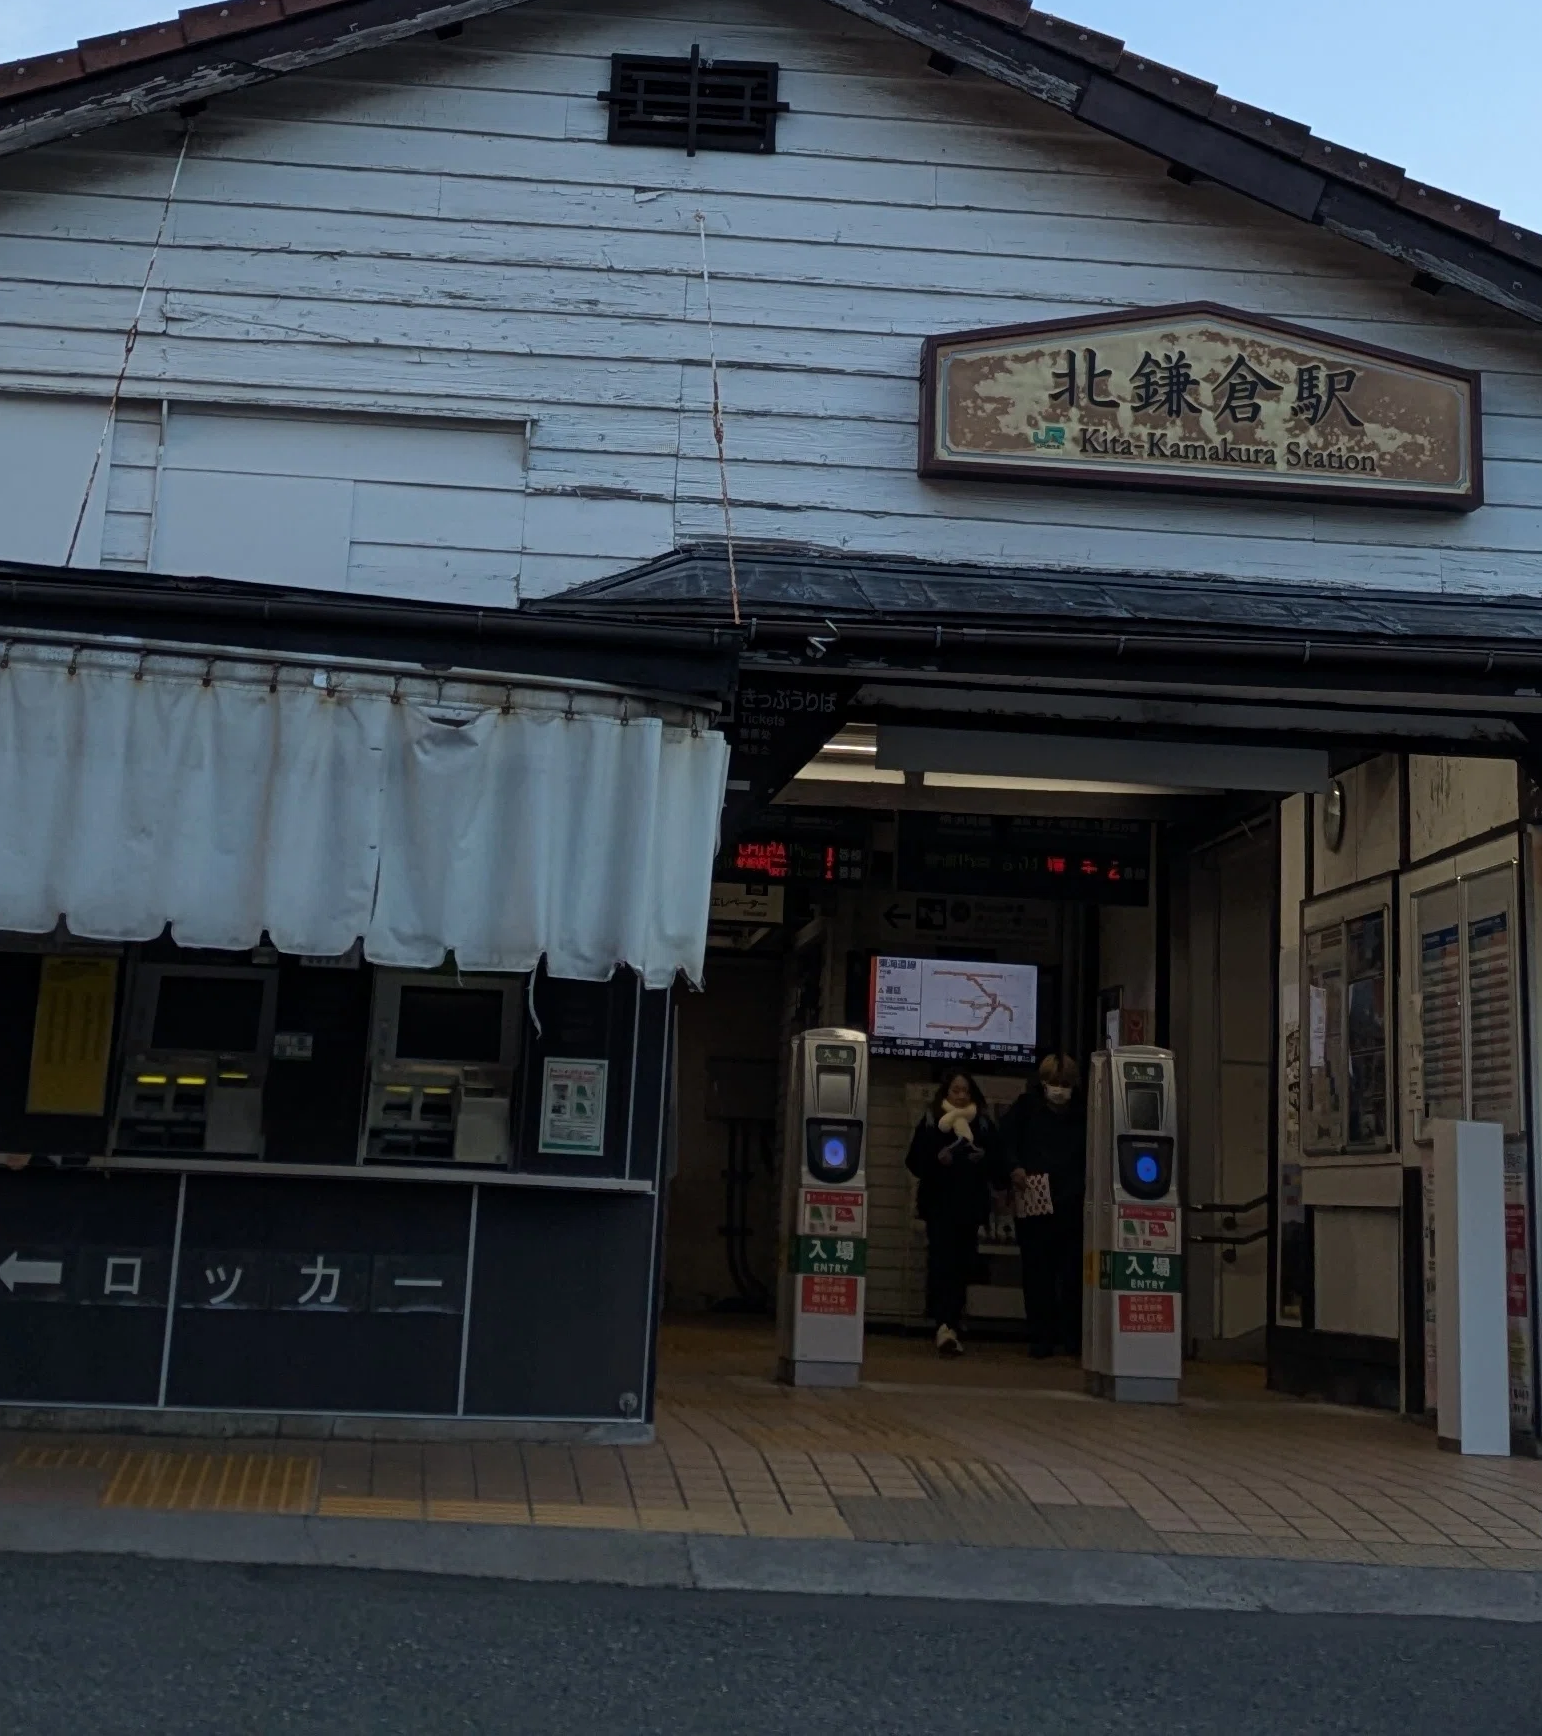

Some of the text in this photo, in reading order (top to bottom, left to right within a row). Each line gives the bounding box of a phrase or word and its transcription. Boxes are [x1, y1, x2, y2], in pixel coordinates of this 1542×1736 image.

[1048, 347, 1366, 429] 北鎌倉駅
[1078, 427, 1378, 473] Kita-Kamakura Station
[740, 688, 840, 713] きっぷうりば
[740, 711, 787, 728] Tickets
[808, 1239, 855, 1262] 入場
[813, 1262, 849, 1274] ENTRY
[1125, 1255, 1171, 1277] 入場
[103, 1255, 444, 1306] ロッカー
[1130, 1278, 1166, 1290] ENTRY
